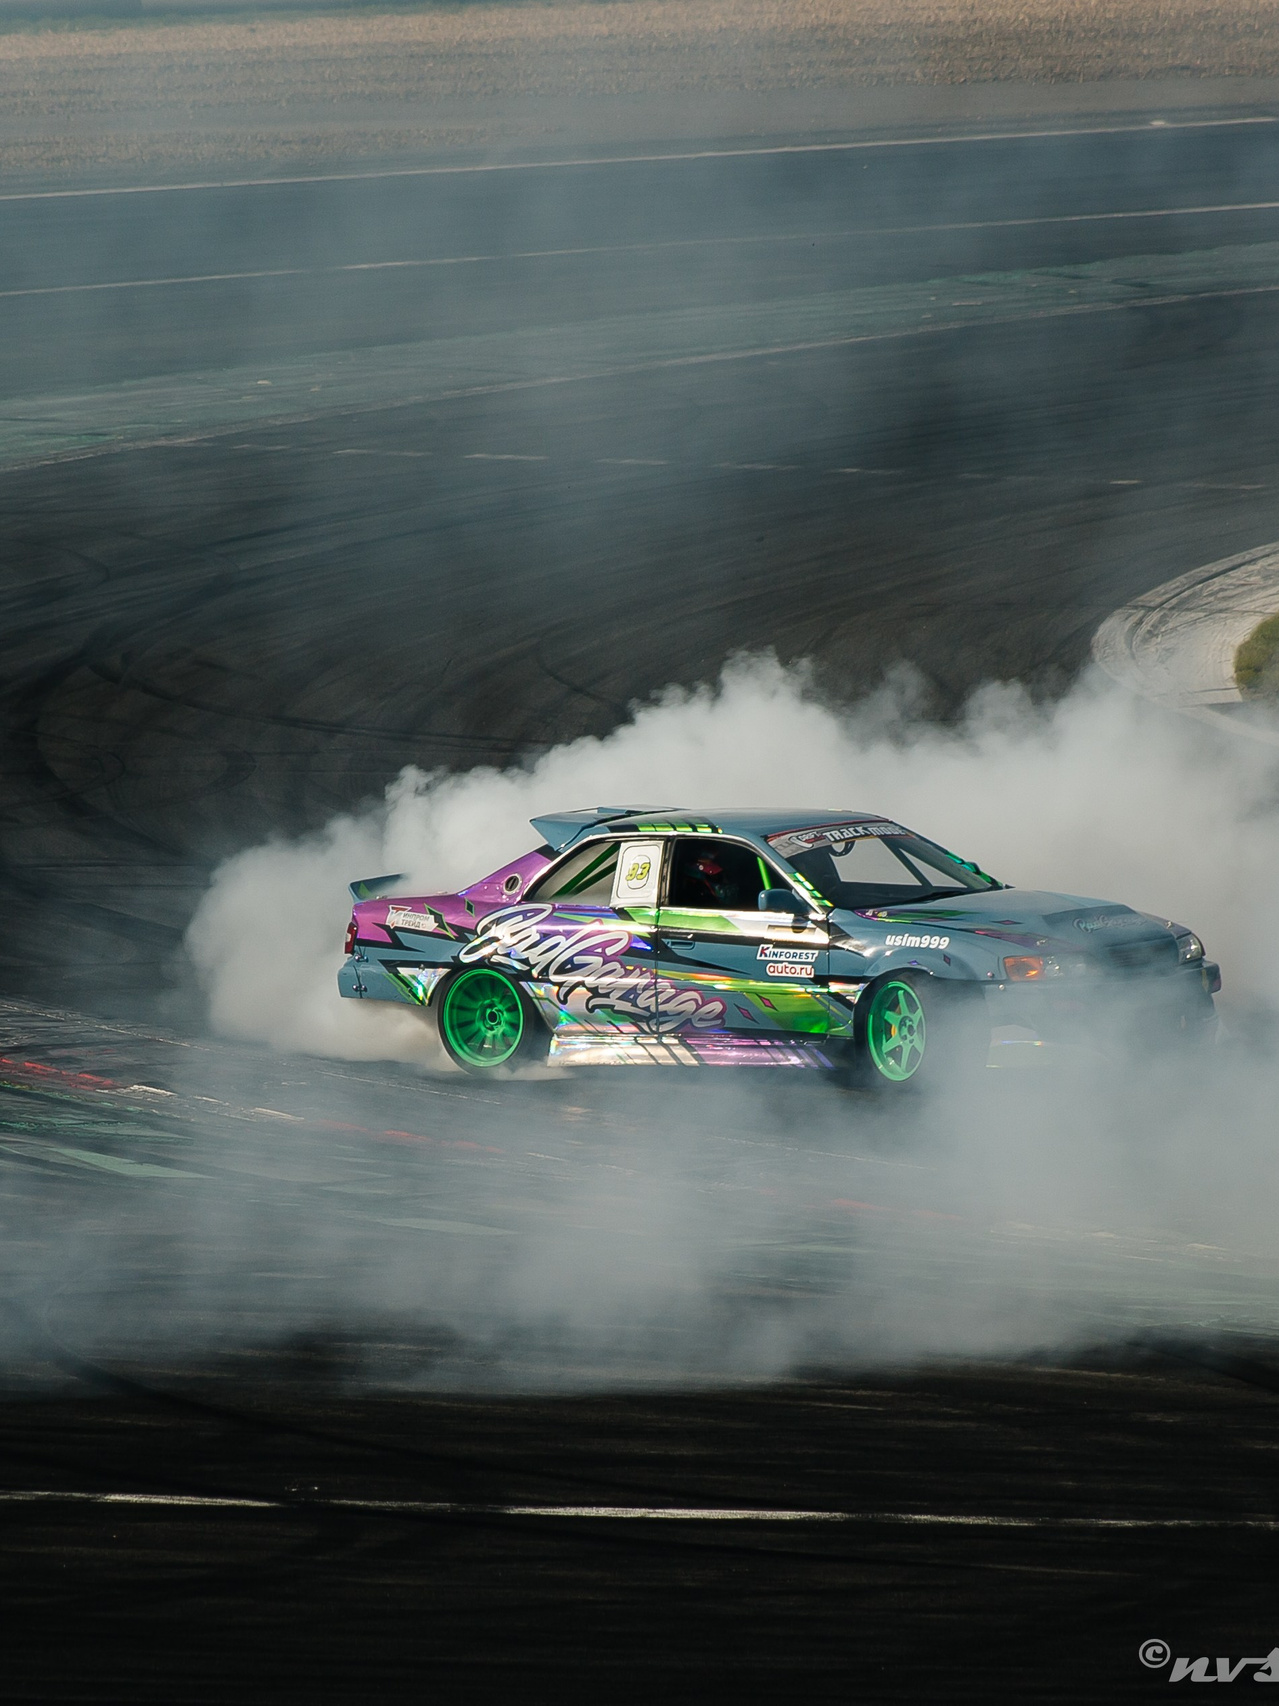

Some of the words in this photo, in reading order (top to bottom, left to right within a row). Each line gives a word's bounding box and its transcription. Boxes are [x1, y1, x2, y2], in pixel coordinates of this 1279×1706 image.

[822, 826, 869, 842] TRACK
[625, 861, 651, 881] 93
[885, 933, 950, 949] usim999
[759, 946, 817, 960] KINFOREST
[767, 964, 813, 976] auto.ru
